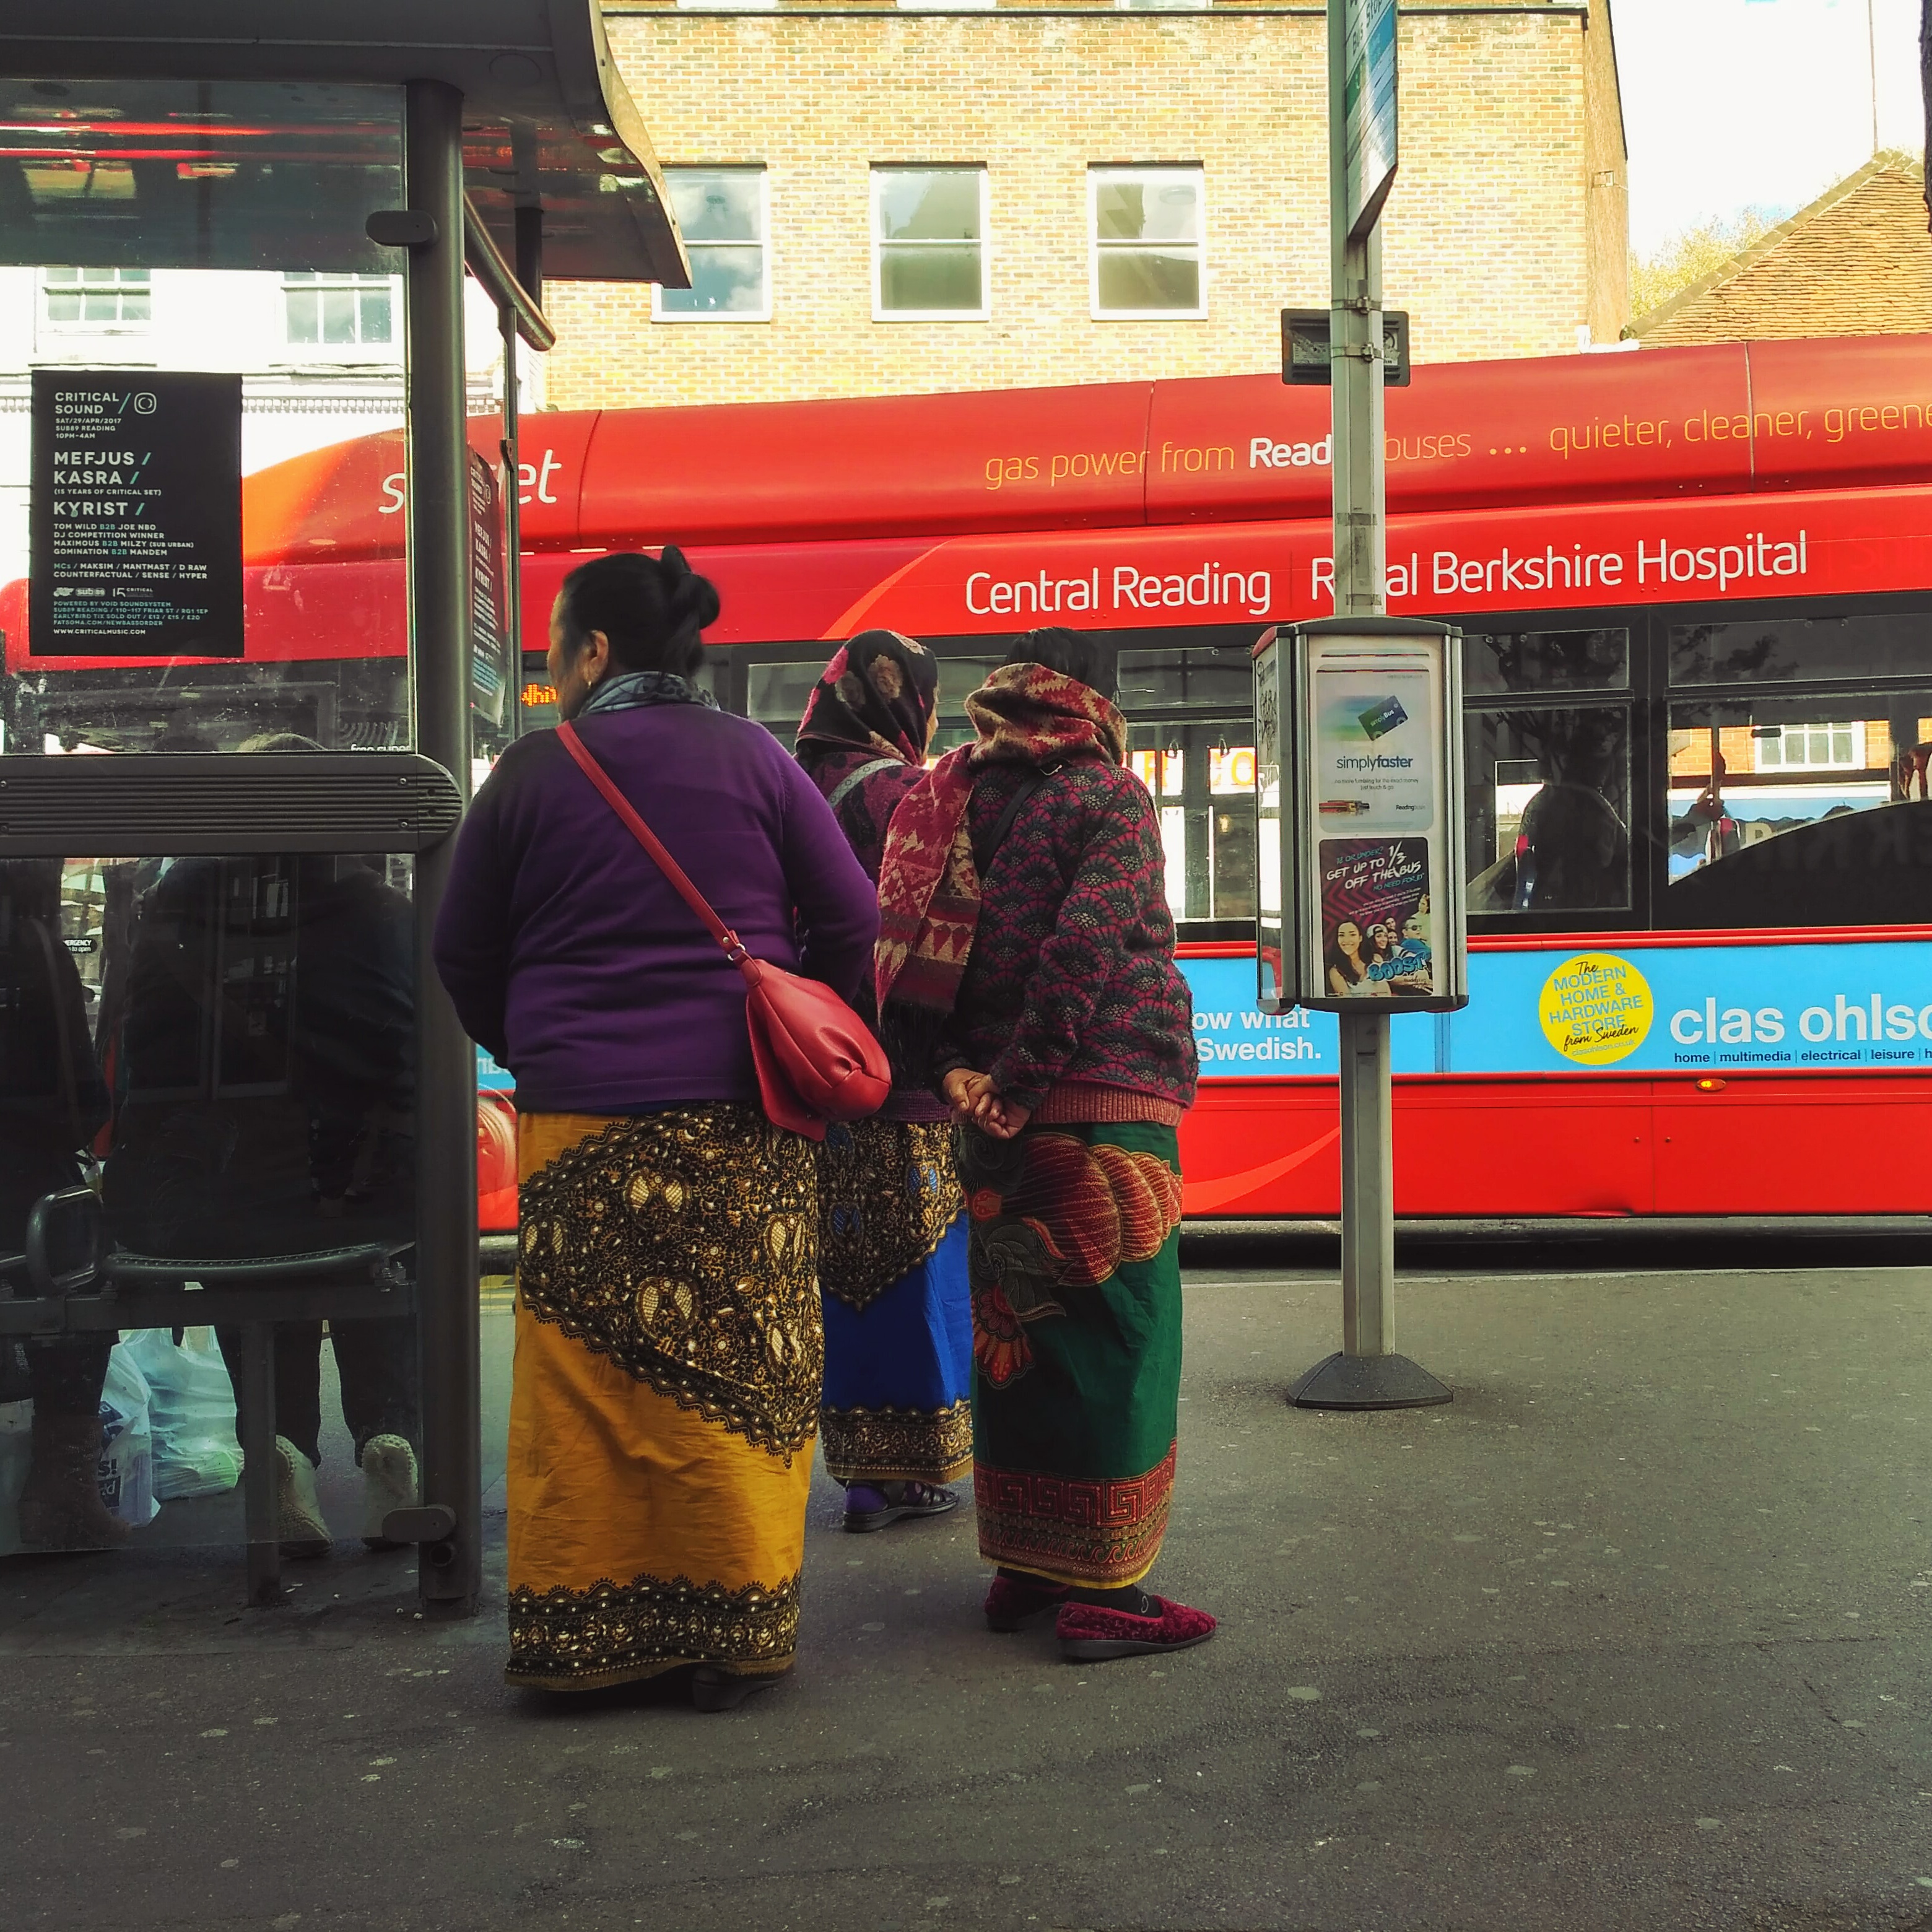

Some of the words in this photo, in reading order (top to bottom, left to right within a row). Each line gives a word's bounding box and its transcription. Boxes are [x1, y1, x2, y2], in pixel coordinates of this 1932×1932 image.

[55, 392, 119, 402] CRITICAL
[55, 405, 103, 414] SOUND
[54, 451, 134, 465] MEFJUS
[985, 456, 1039, 490] gas
[1051, 449, 1150, 487] power
[1161, 442, 1234, 472] from
[1250, 433, 1332, 468] Read
[1550, 415, 1671, 459] quieter,
[1684, 409, 1812, 442] cleaner,
[54, 471, 123, 484] KASRA
[54, 502, 128, 517] KYRIST
[966, 567, 1099, 615] Central
[1113, 562, 1270, 616] Reading
[1312, 552, 1417, 601] Ral
[1434, 544, 1623, 594] Berkshire
[1638, 529, 1806, 591] Hospital
[1336, 754, 1413, 772] simplyfaster
[1326, 867, 1350, 881] GET
[1354, 862, 1367, 874] UP
[1369, 858, 1385, 870] TO
[1344, 874, 1369, 889] OFF
[1373, 868, 1395, 882] THE
[1399, 861, 1422, 876] BUS
[1384, 880, 1401, 889] NEED
[1368, 951, 1427, 982] BOOST
[1553, 965, 1627, 991] MODERN
[1575, 961, 1599, 976] The
[1560, 985, 1611, 1006] HOME
[1615, 982, 1627, 996] &
[1549, 994, 1644, 1024] HARDWARE
[1572, 1014, 1627, 1037] STORE
[1670, 997, 1785, 1045] clas
[1197, 1036, 1321, 1061] Swedish.
[1564, 1035, 1592, 1051] from
[1595, 1024, 1639, 1043] Sweden
[1674, 1052, 1710, 1063] home
[1720, 1051, 1791, 1063] multimedia
[1801, 1049, 1861, 1061] electrical
[1871, 1048, 1915, 1060] leisure
